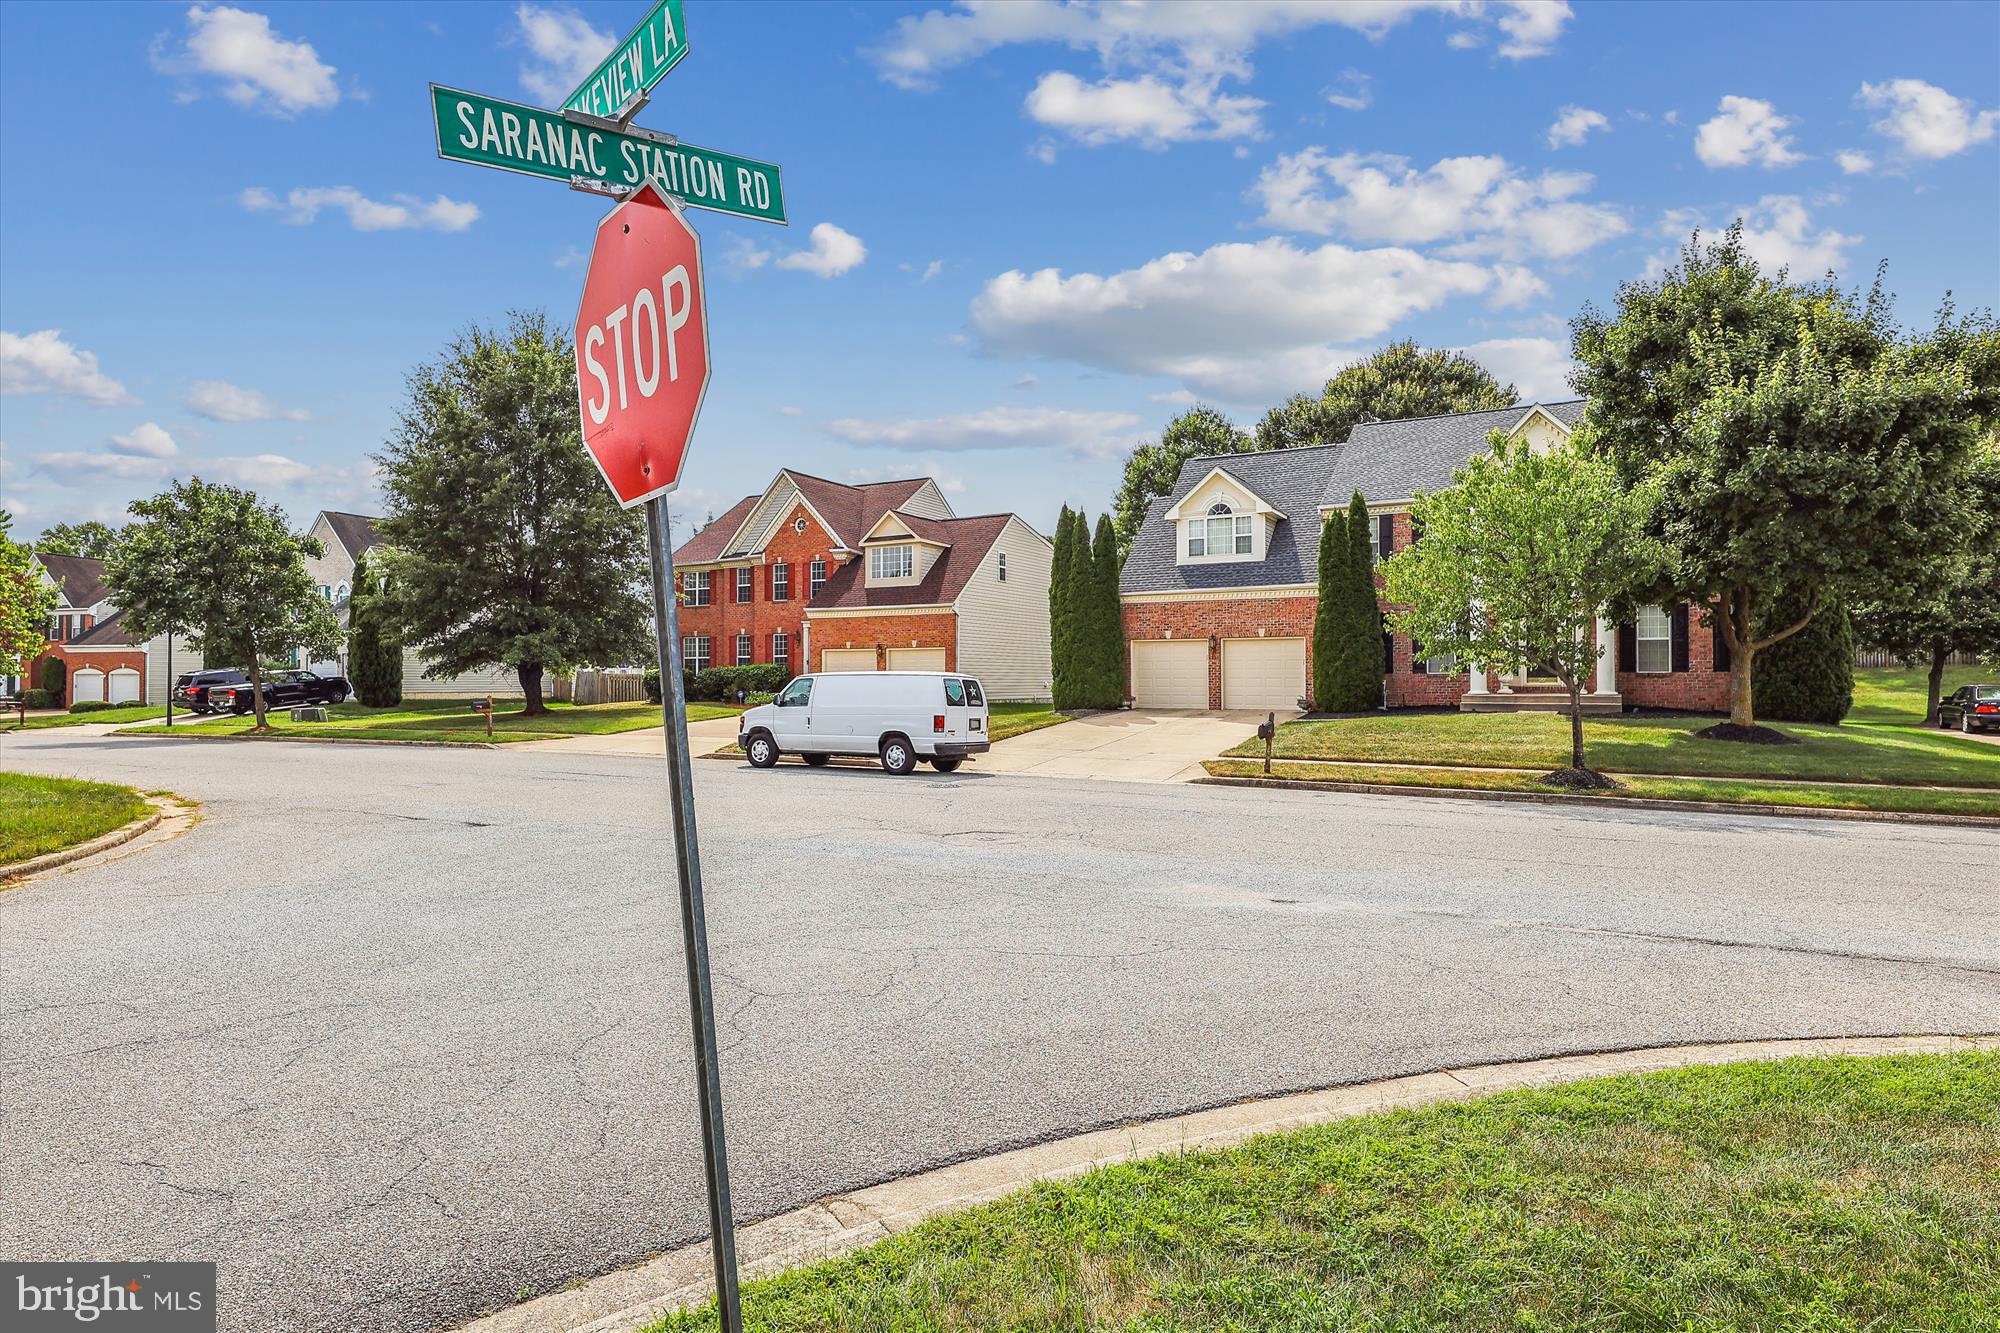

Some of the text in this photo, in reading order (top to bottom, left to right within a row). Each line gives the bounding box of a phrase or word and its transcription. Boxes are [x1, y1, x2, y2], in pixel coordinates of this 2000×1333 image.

[573, 6, 678, 117] KEVIEW LA
[456, 101, 770, 210] SARANAC STATION RD
[585, 264, 691, 425] STOP
